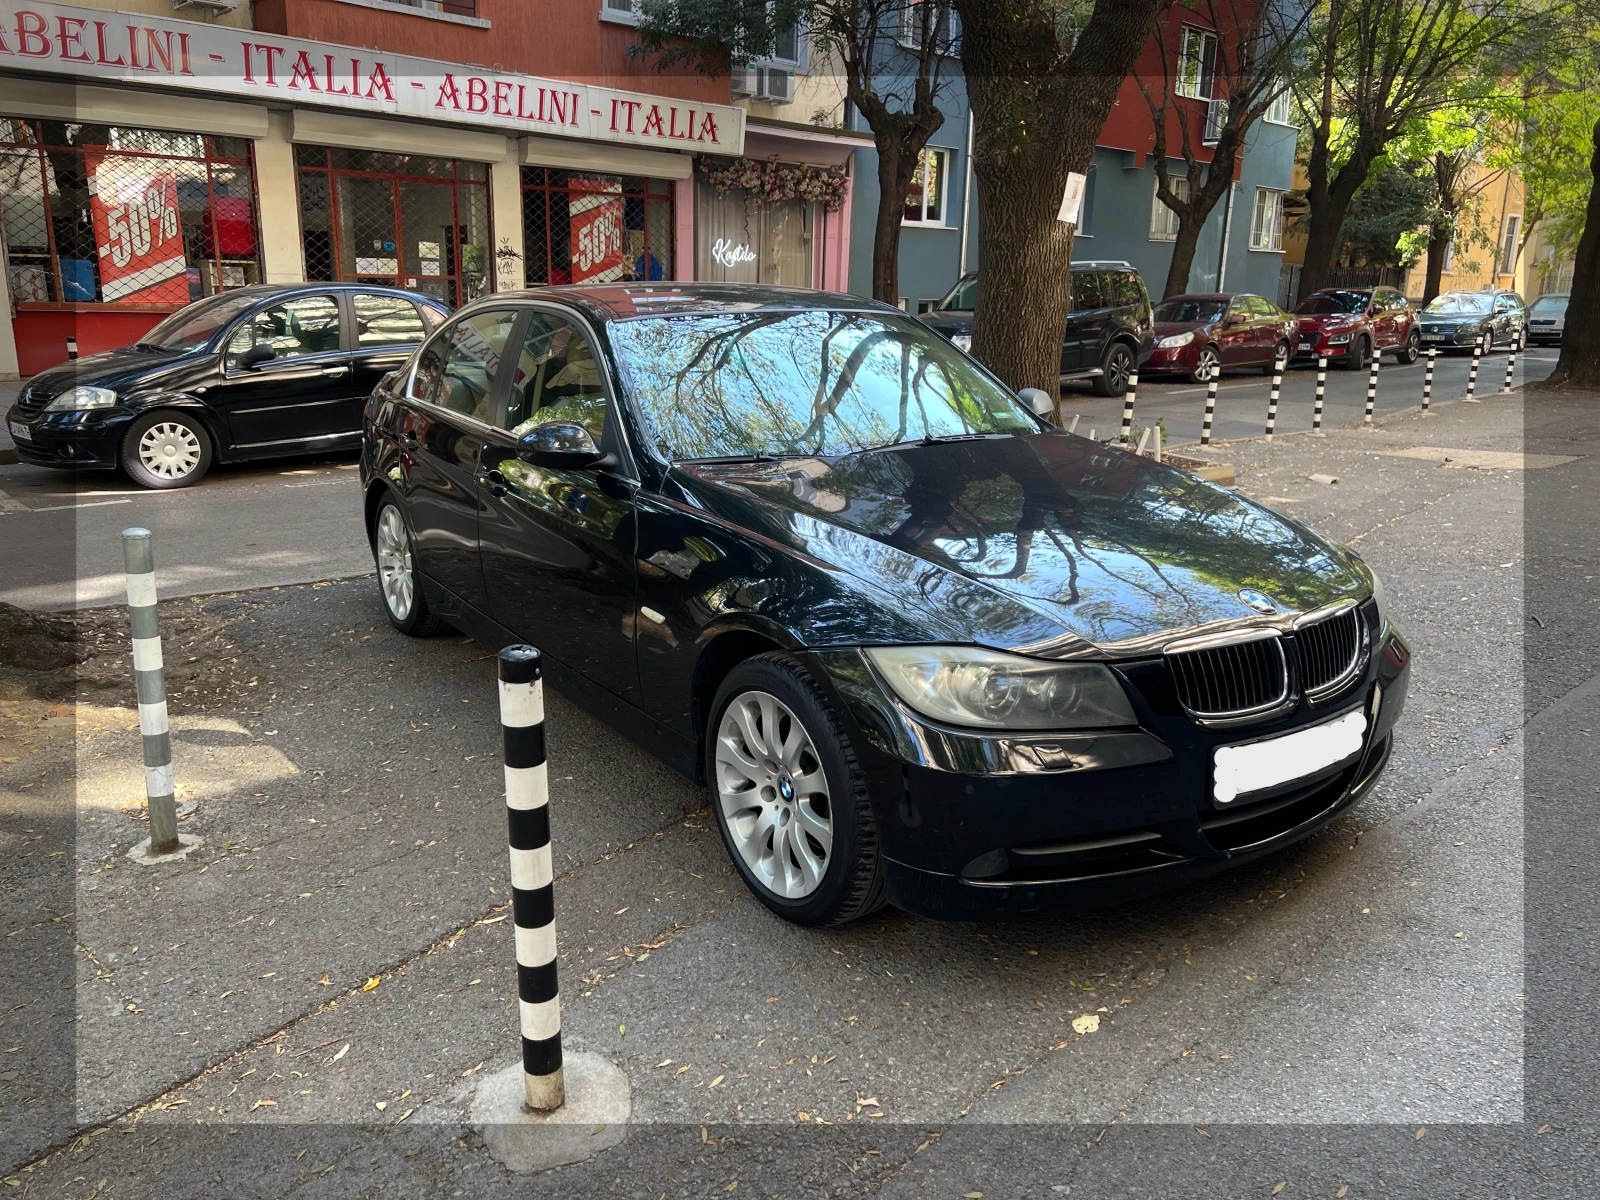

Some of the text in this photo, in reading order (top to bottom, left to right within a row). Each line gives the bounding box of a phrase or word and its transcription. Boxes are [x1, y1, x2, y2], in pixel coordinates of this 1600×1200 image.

[241, 42, 398, 103] ITALIA
[434, 73, 580, 128] ABELINI
[609, 98, 721, 144] ITALIA
[572, 207, 620, 272] -50%
[712, 238, 757, 268] Kastilo
